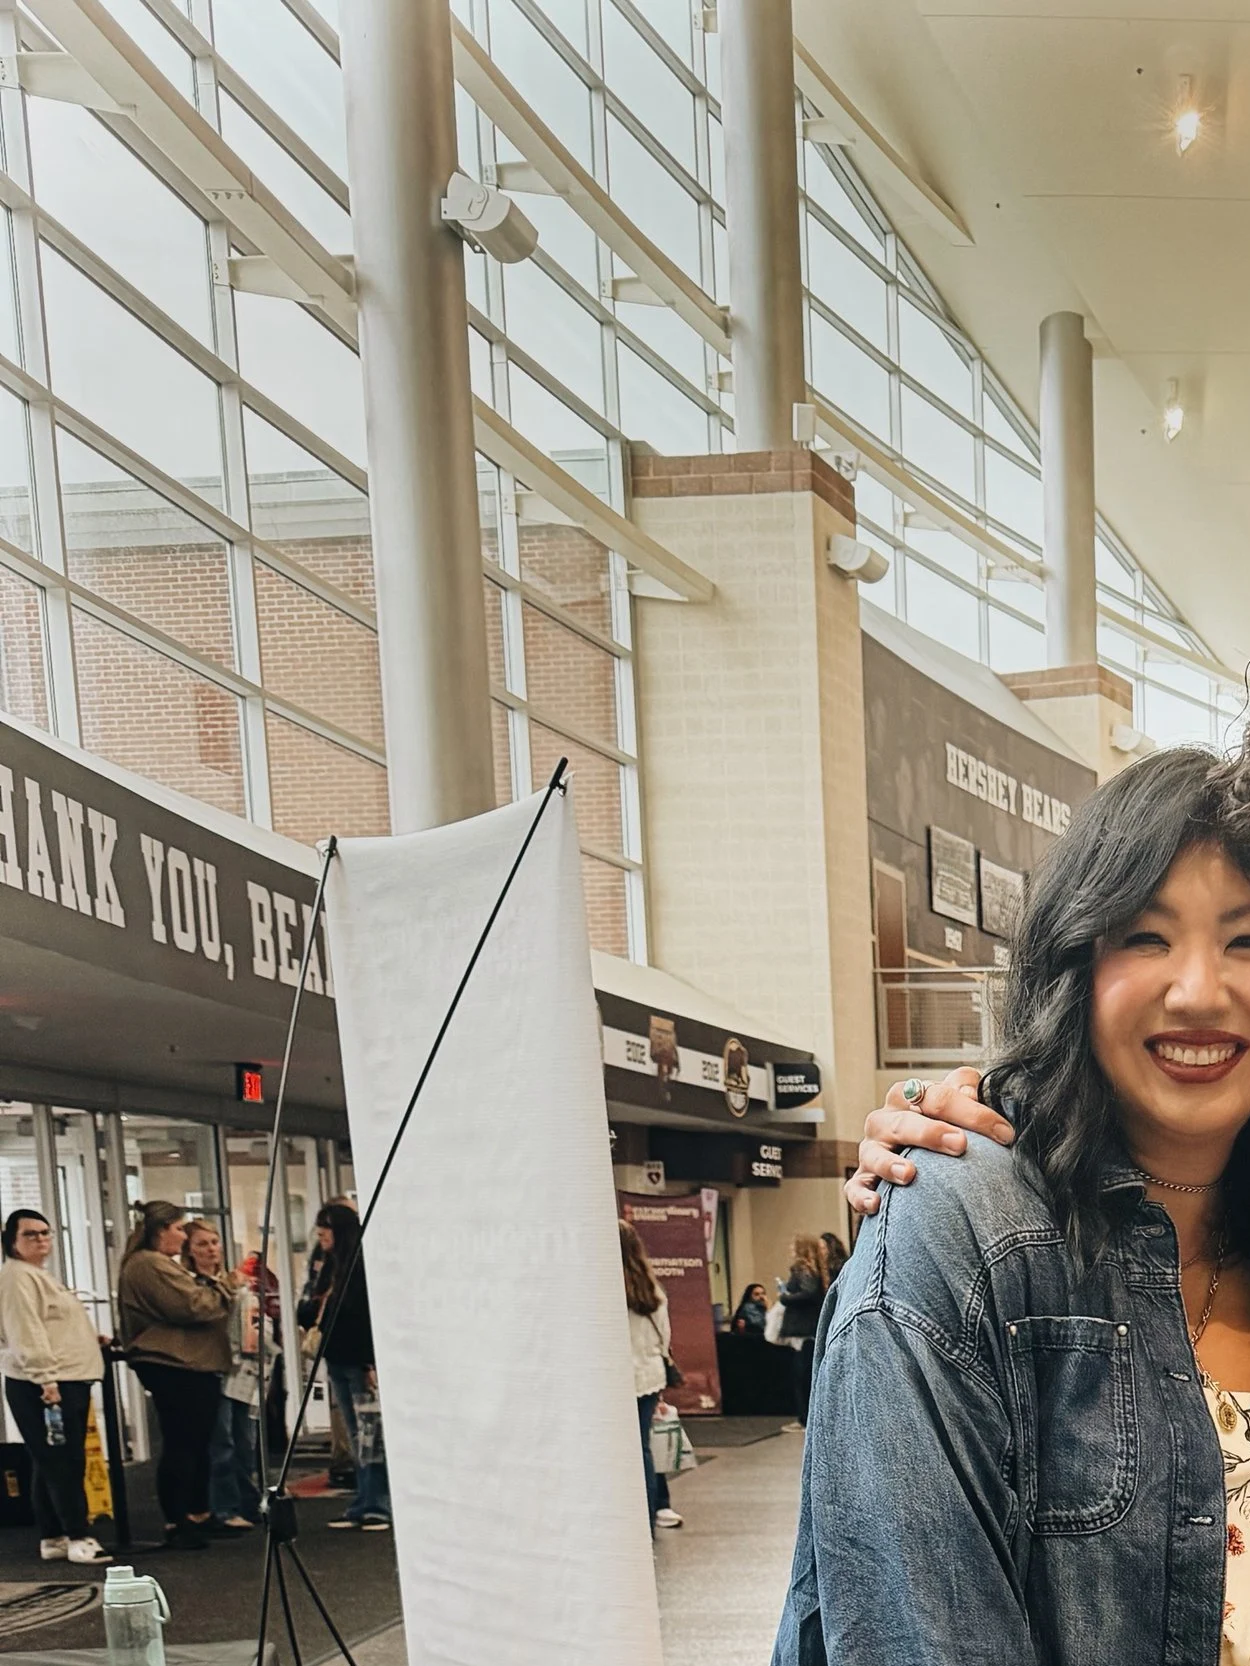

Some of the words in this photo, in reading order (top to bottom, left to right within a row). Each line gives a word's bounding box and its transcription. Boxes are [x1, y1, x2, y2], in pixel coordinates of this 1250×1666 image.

[945, 741, 1018, 816] HERSHEY
[1021, 783, 1071, 836] BEARS
[140, 833, 234, 981] YOU,
[776, 1075, 806, 1084] GUEST
[777, 1084, 819, 1093] SERVICES
